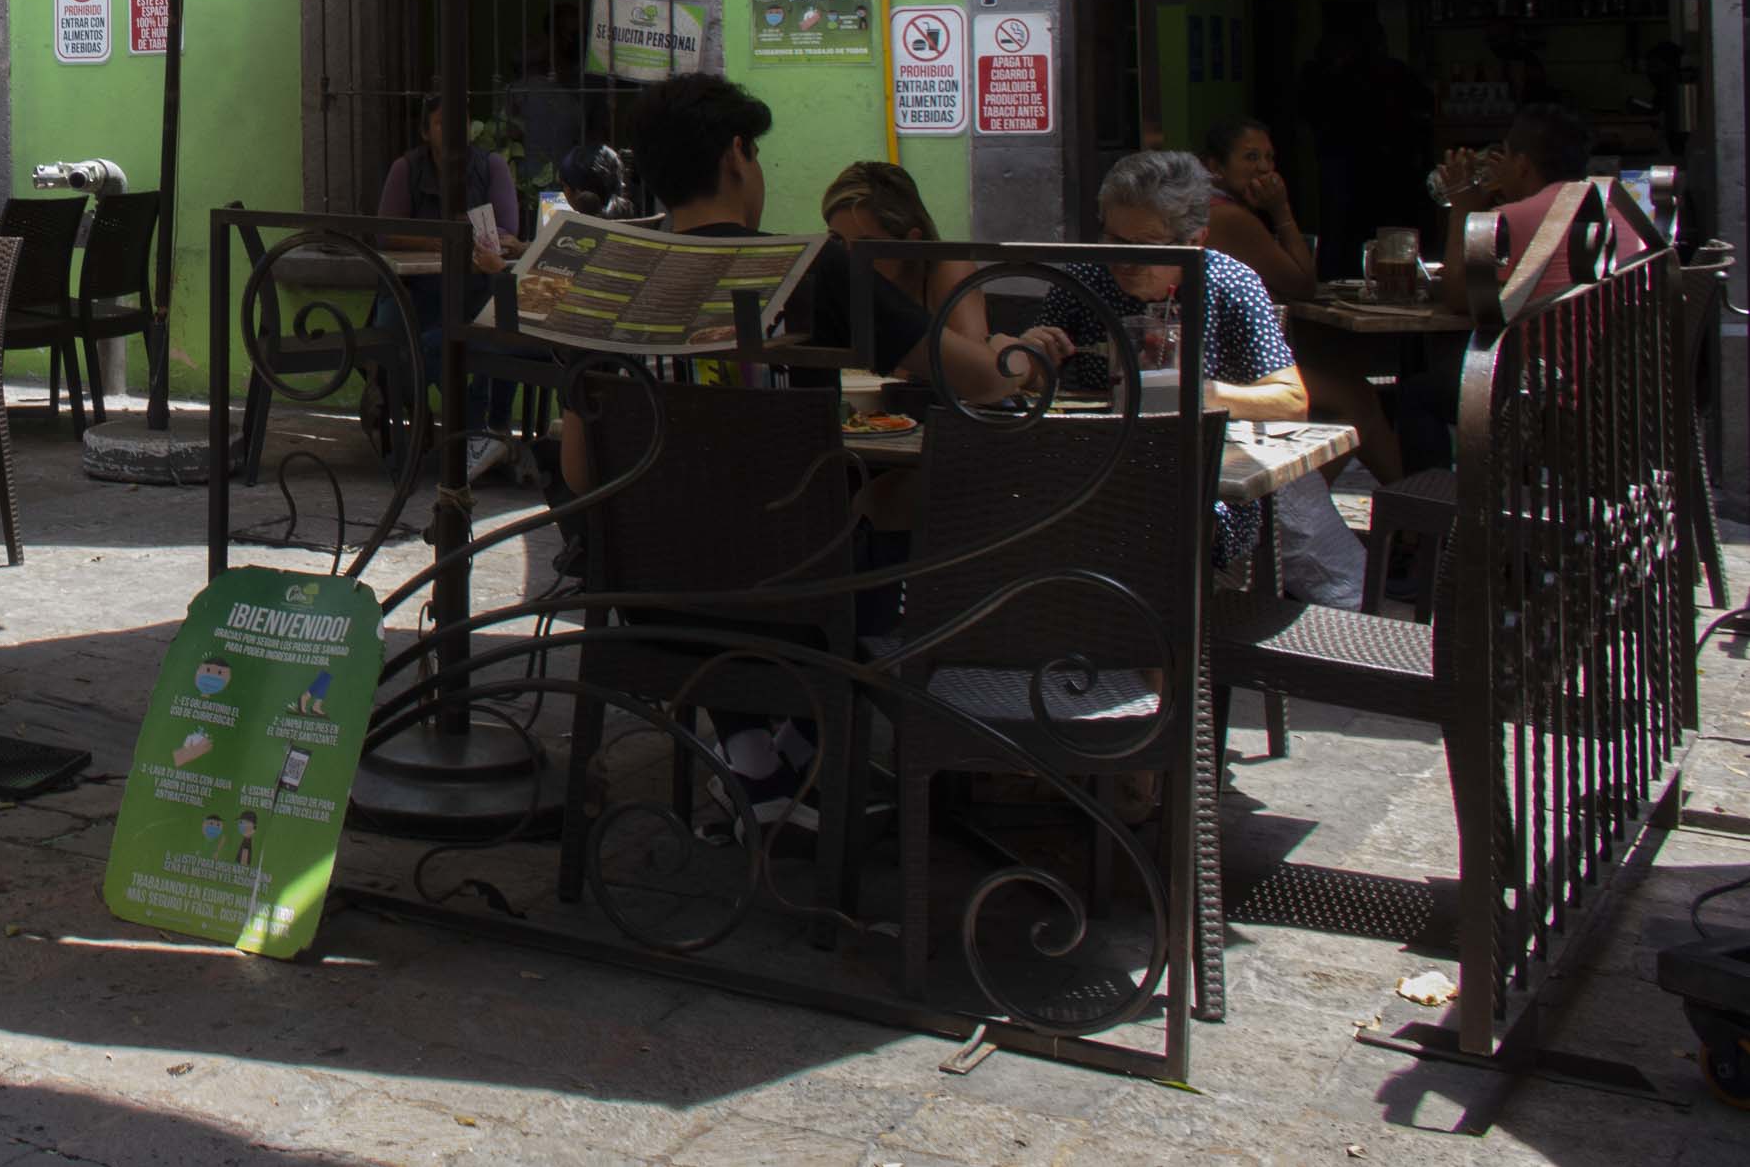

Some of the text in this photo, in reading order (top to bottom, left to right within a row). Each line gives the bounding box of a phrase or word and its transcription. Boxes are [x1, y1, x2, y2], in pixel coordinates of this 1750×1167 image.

[64, 4, 102, 16] PROHIBIDO
[61, 17, 105, 29] ENTRAR CON
[136, 17, 169, 28] 100% LIB
[63, 30, 103, 41] ALIMENTOS
[140, 28, 168, 39] DE HUM
[596, 24, 606, 40] SE
[646, 33, 696, 52] PERSONAL
[65, 42, 102, 53] Y BEBIDAS
[138, 39, 167, 50] DE TABA
[992, 56, 1034, 68] APAGA TU
[900, 65, 954, 78] PROHIBIDO
[990, 69, 1036, 80] CIGARRO O
[896, 79, 959, 93] ENTRAR CON
[990, 81, 1037, 93] CUALQUIER
[899, 95, 956, 108] ALIMENTOS
[985, 93, 1043, 105] PRODUCTO DE
[901, 110, 954, 123] Y BEBIDAS
[983, 106, 1046, 118] TABACO ANTES
[990, 118, 1038, 130] DE ENTRAR
[226, 602, 351, 643] ¡BIENVENIDO!
